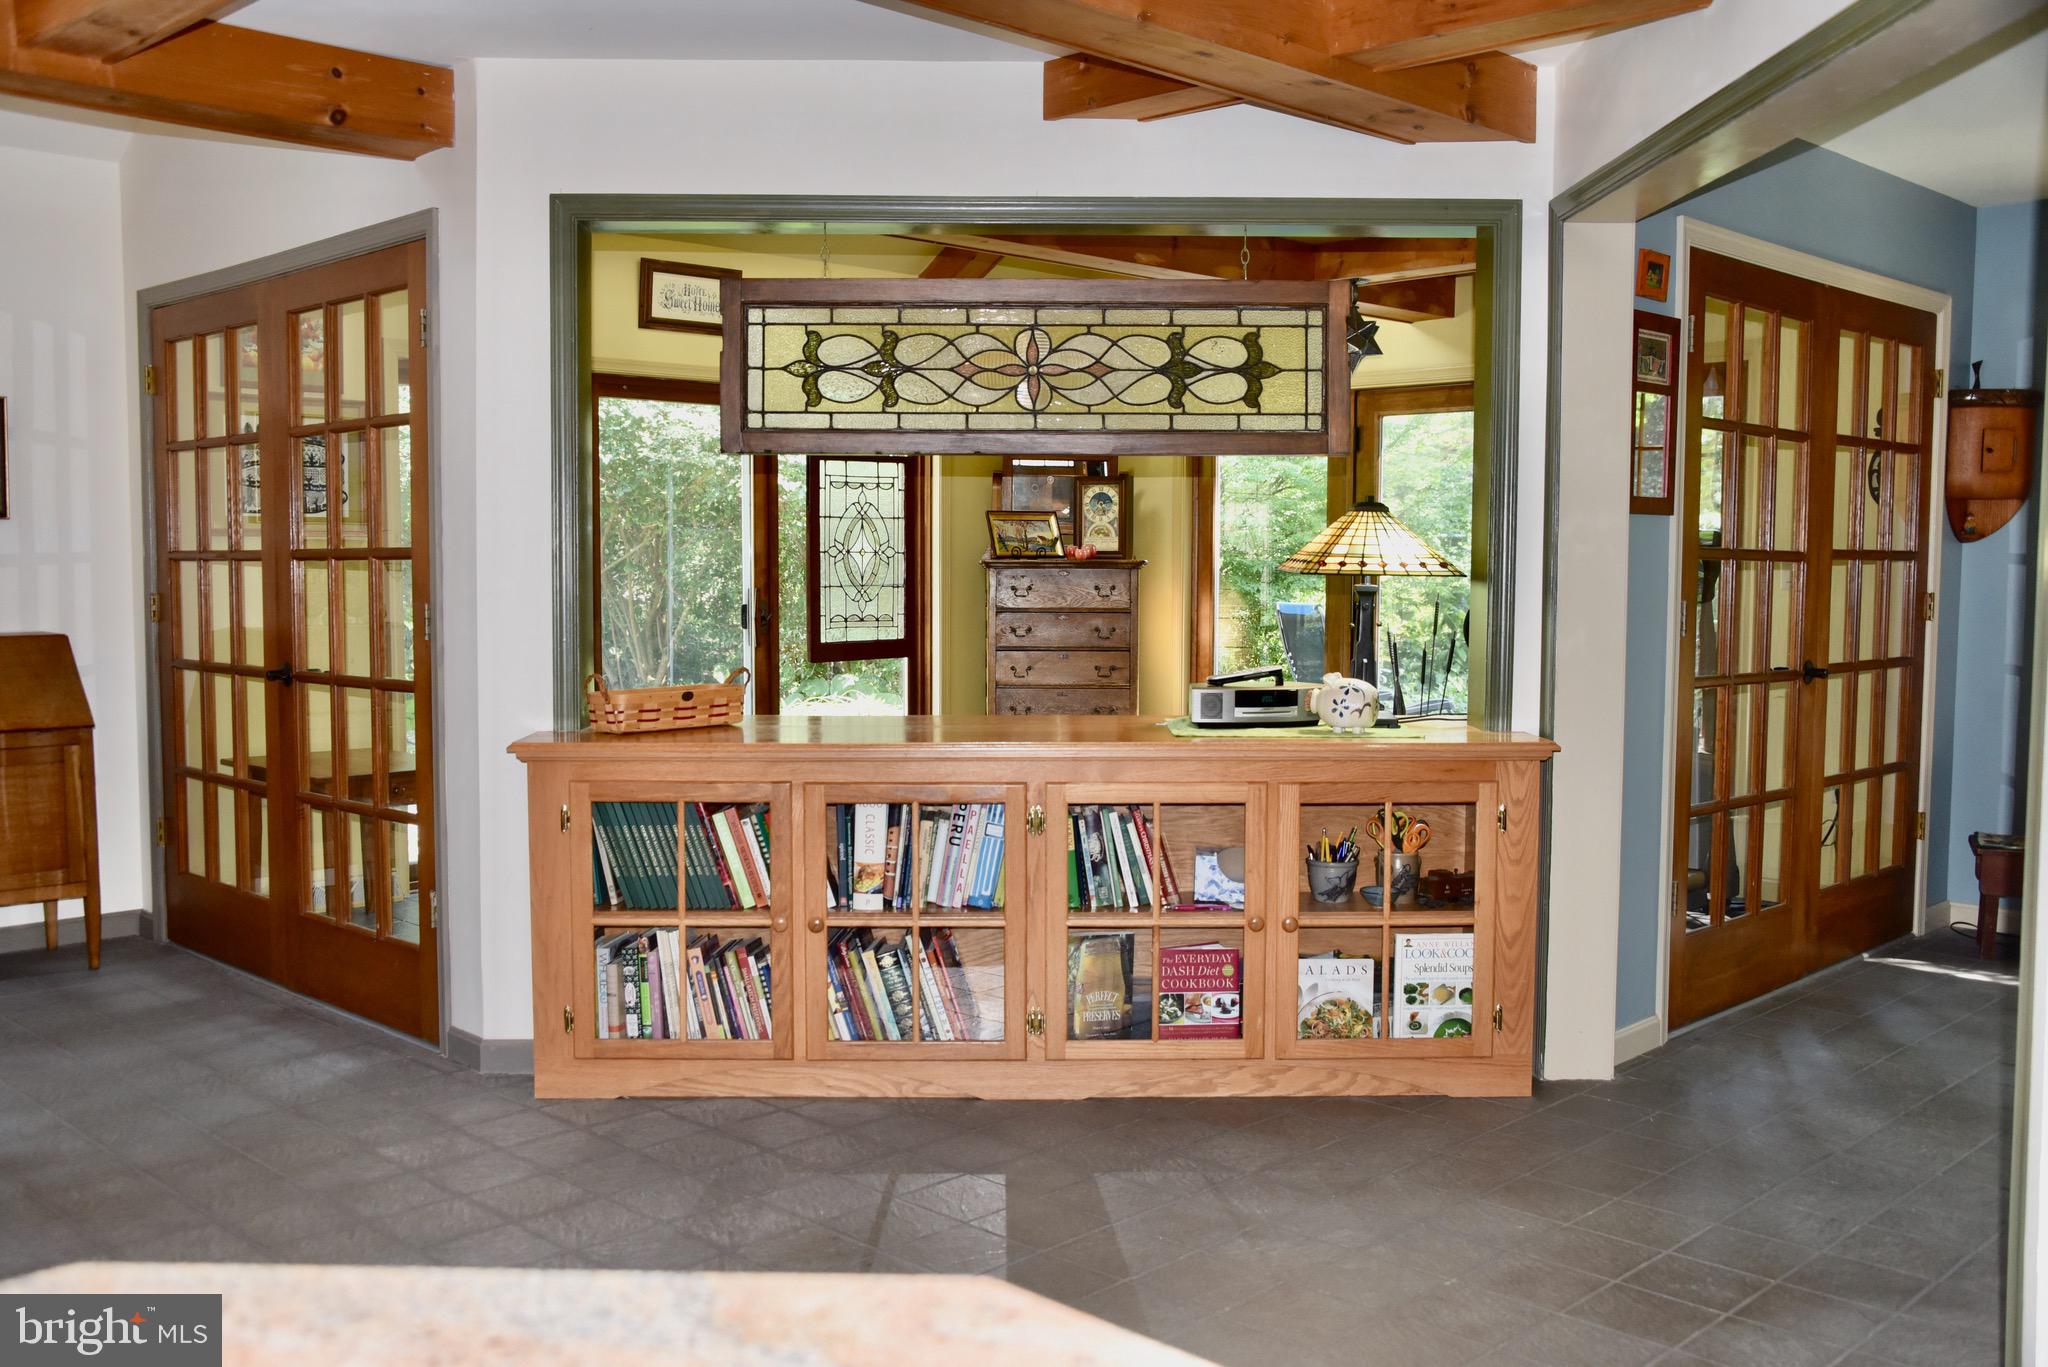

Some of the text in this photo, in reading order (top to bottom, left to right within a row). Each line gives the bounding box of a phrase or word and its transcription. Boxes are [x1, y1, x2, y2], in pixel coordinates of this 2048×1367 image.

[664, 289, 721, 313] Sweet Home
[864, 814, 875, 855] CLASSIC
[956, 810, 977, 892] PAELLA
[1175, 953, 1234, 964] EVERYDAY
[1405, 948, 1473, 960] LOOK&COO
[1162, 965, 1221, 976] DASH Diet
[1305, 964, 1368, 976] ALADS
[1413, 962, 1473, 976] Splendid Soups
[1161, 977, 1235, 989] COOKBOOK
[1086, 991, 1120, 1005] PERFECT
[1082, 1009, 1121, 1022] PRESERVES
